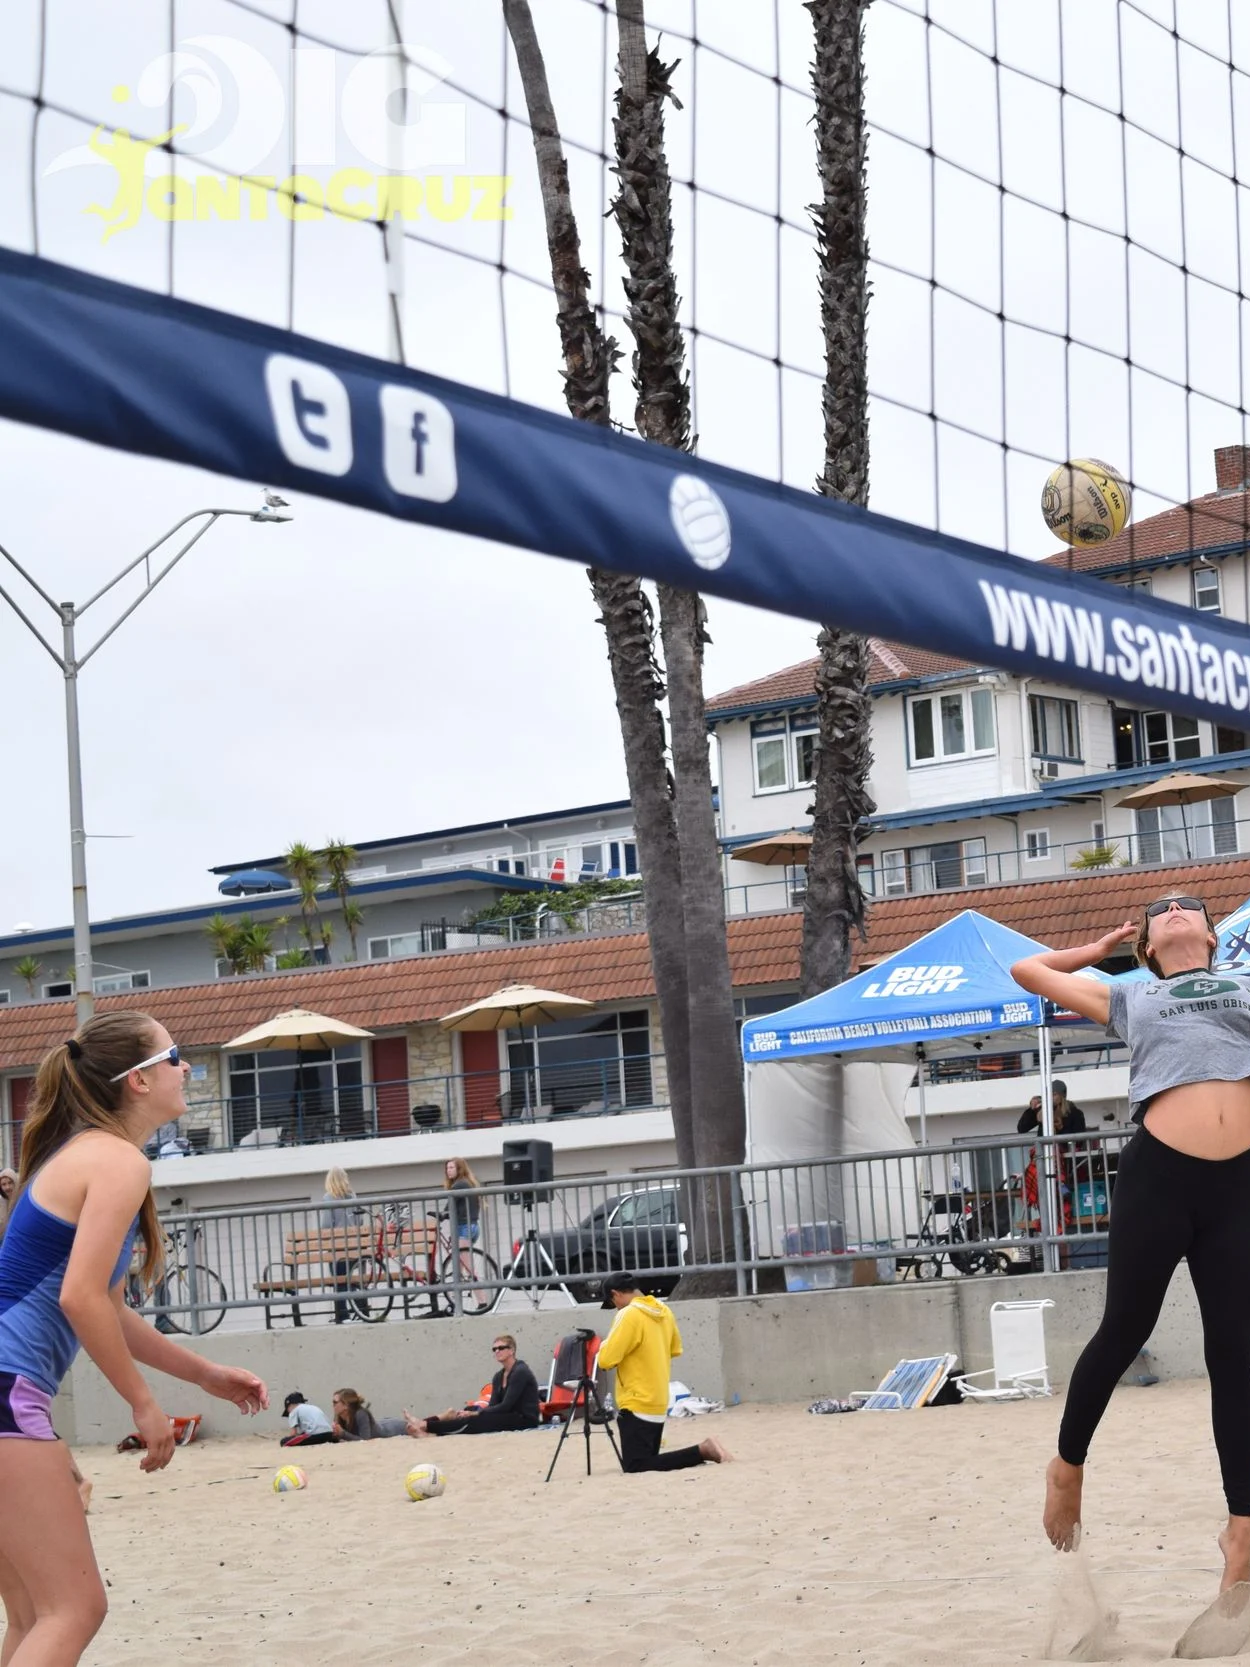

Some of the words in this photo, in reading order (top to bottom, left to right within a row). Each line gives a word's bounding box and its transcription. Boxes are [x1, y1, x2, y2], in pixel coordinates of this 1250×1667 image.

[1087, 486, 1108, 520] Wilson
[886, 965, 964, 983] BUD
[861, 978, 969, 999] LIGHT
[1000, 1010, 1034, 1024] LIGHT
[1002, 1002, 1029, 1014] BUD
[1160, 1005, 1186, 1019] SAN
[1190, 999, 1218, 1013] LUIS
[789, 1027, 844, 1046] CALIFORNIA
[844, 1021, 875, 1039] BEACH
[875, 1015, 930, 1036] VOLLEYBALL
[929, 1009, 993, 1029] ASSOCIATION
[750, 1039, 783, 1053] LIGHT
[753, 1031, 777, 1043] BUD
